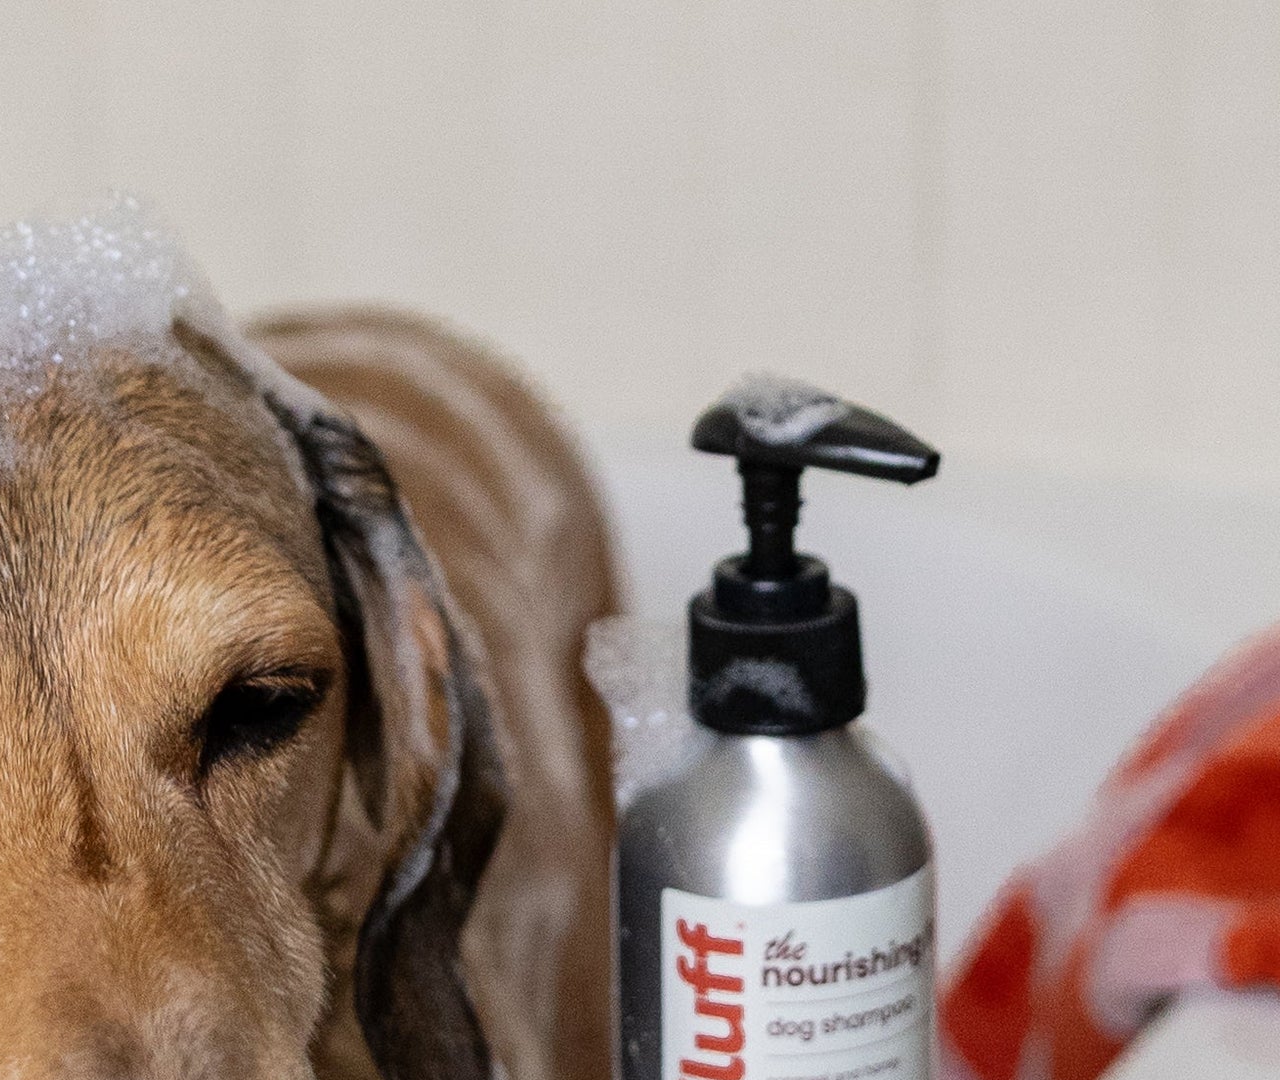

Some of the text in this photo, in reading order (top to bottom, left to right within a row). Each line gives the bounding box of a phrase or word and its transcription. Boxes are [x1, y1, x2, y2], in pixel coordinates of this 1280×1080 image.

[761, 935, 922, 987] nourishing
[765, 929, 807, 961] the
[768, 1016, 815, 1041] dog
